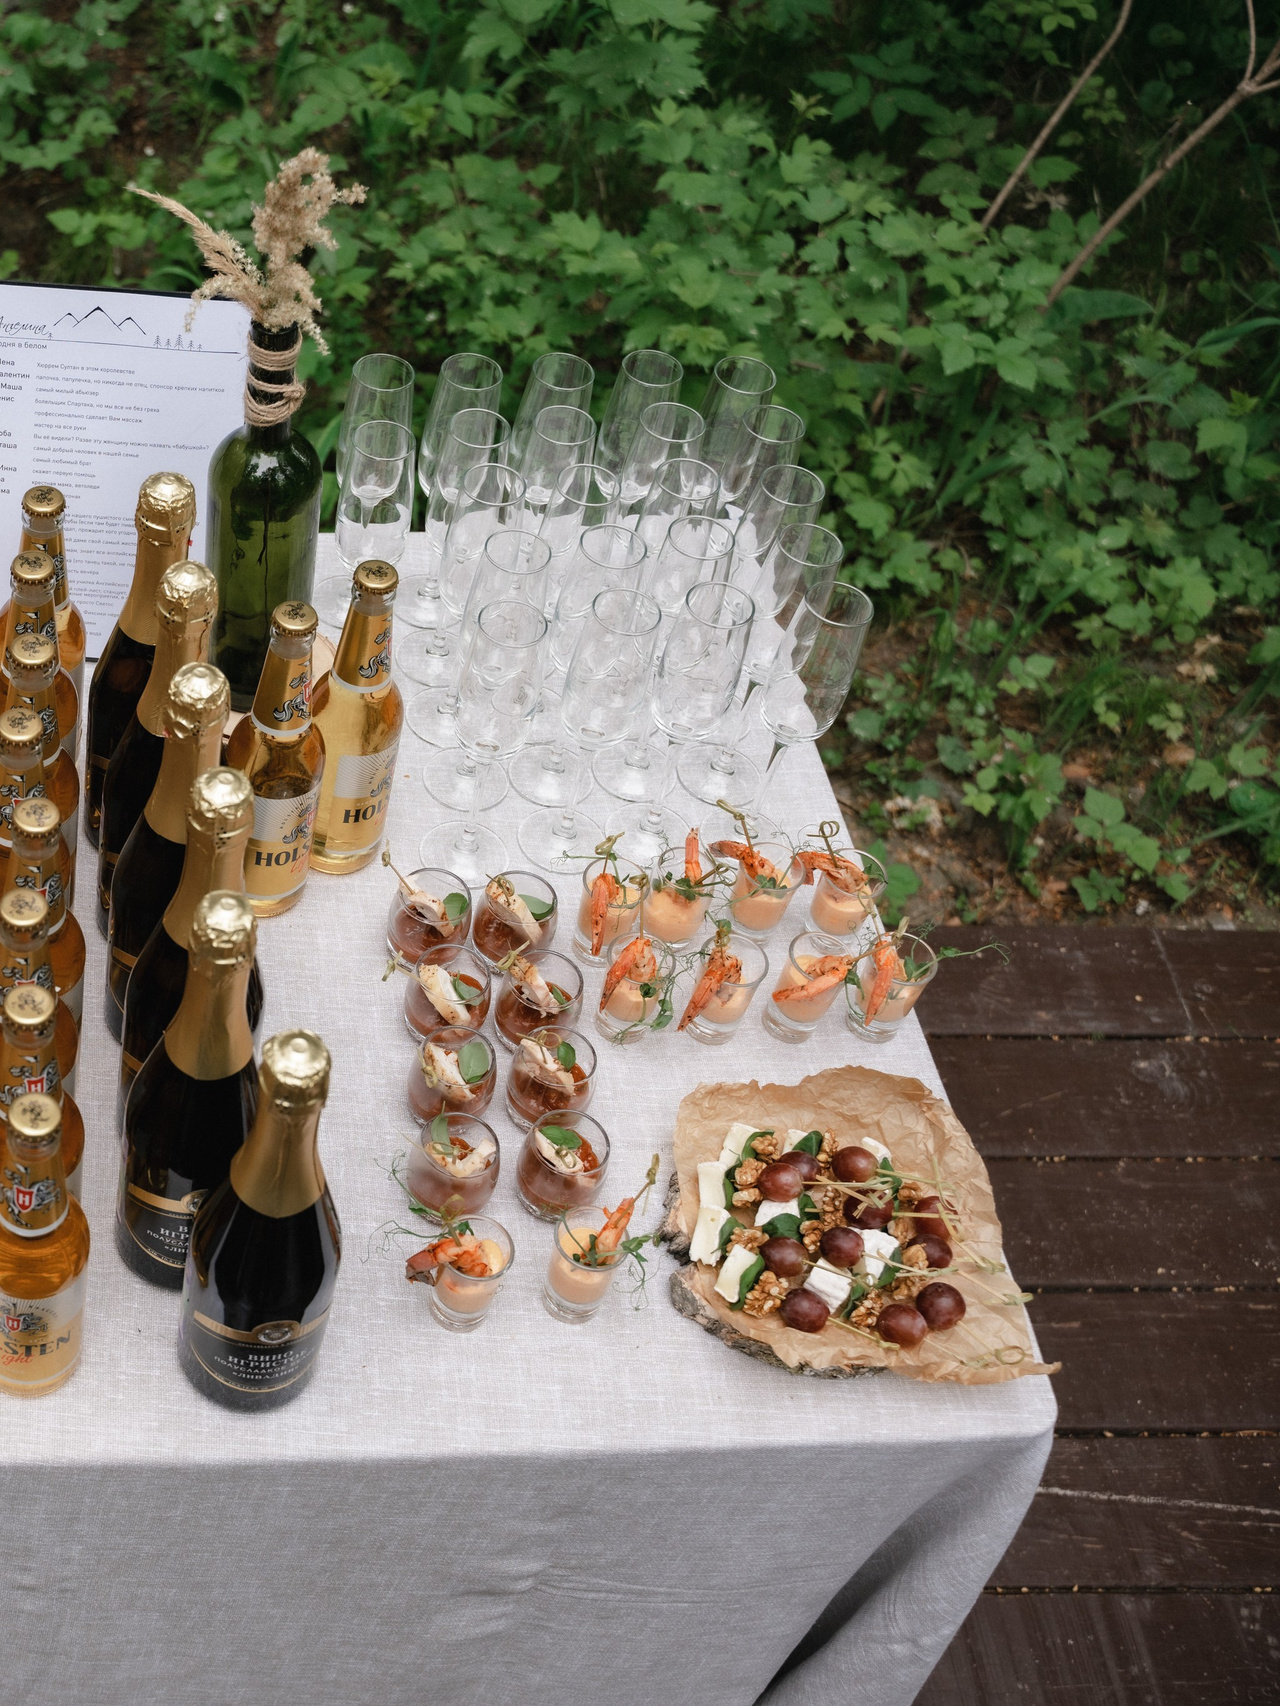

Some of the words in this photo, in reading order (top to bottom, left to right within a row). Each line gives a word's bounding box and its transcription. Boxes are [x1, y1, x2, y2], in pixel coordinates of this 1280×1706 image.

[23, 339, 48, 350] белом
[0, 380, 23, 391] Маша
[254, 842, 310, 867] HOLS
[19, 1193, 30, 1205] H
[8, 1319, 18, 1329] H
[228, 1350, 308, 1368] ИГРИСТОЕ
[248, 1350, 293, 1361] ВИНО
